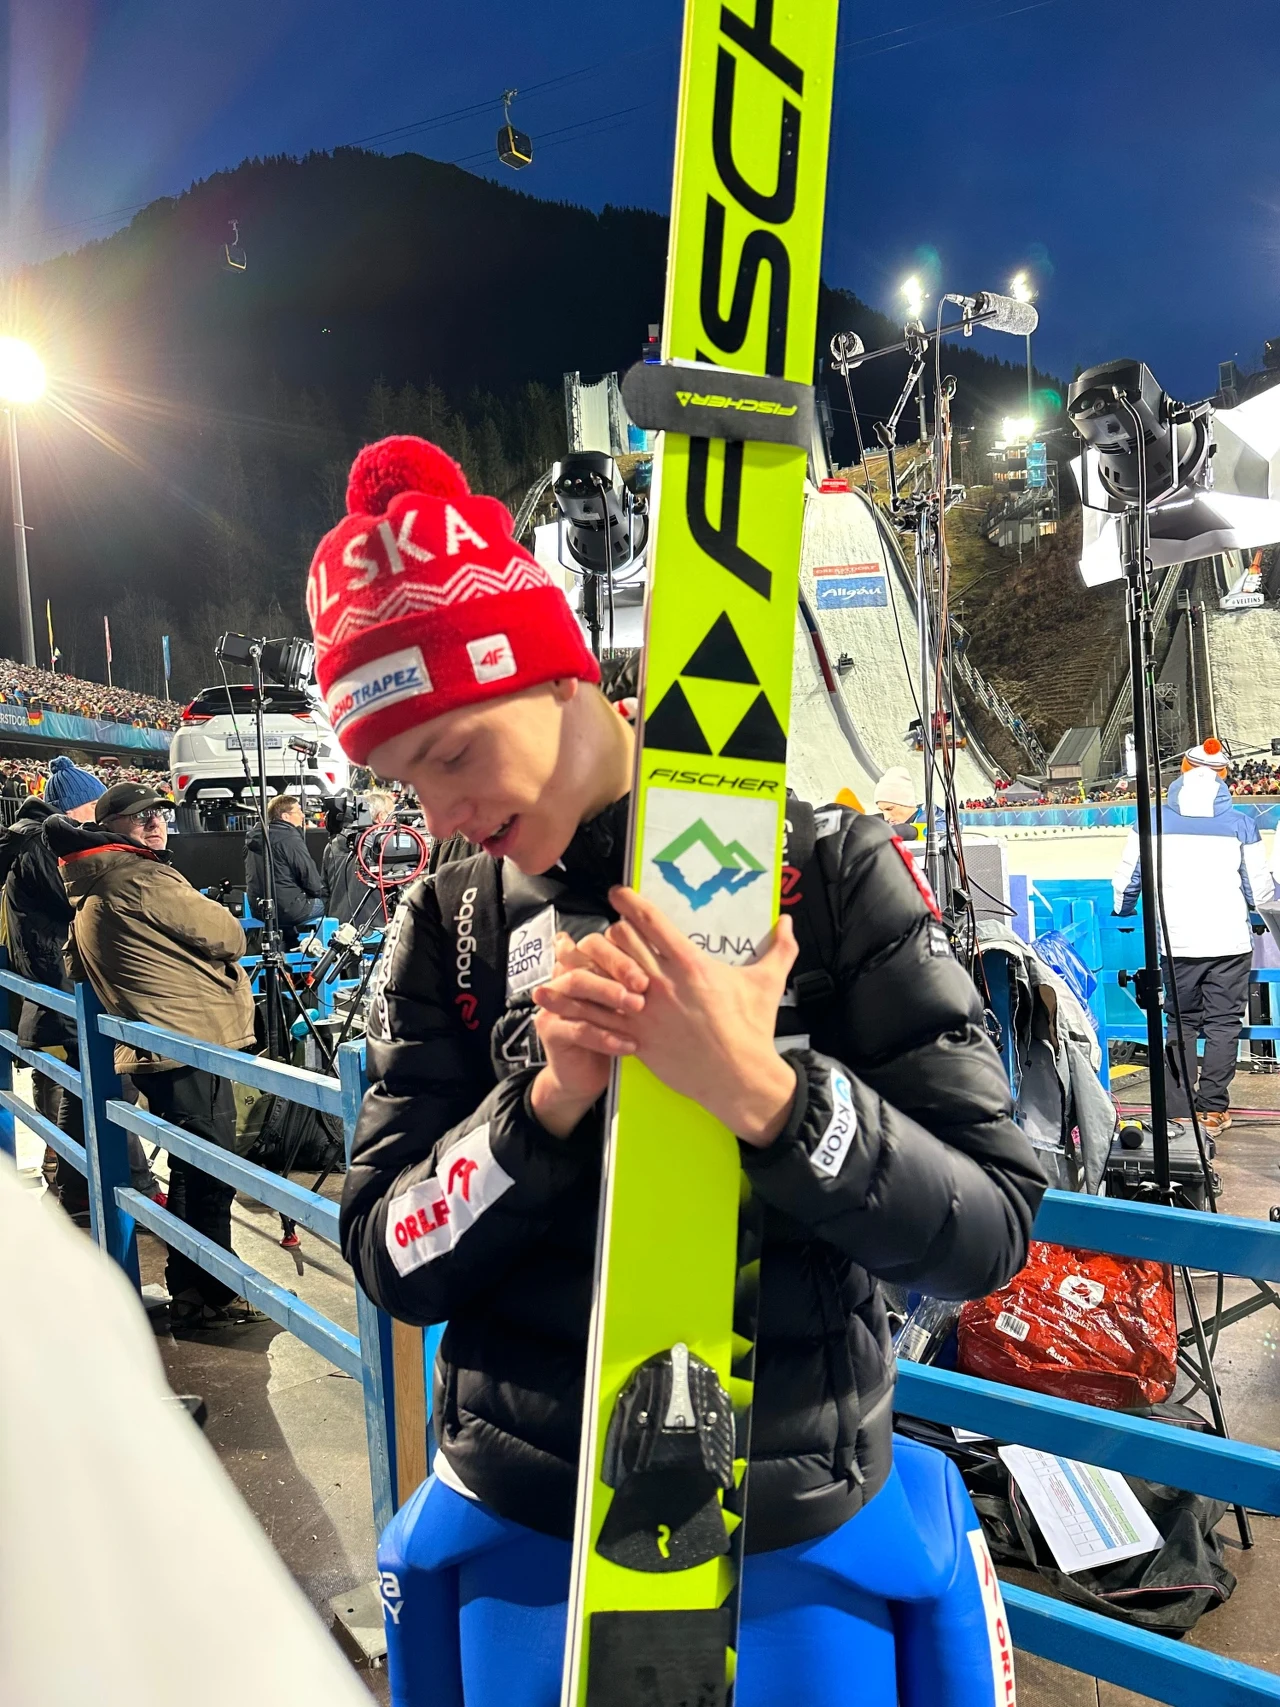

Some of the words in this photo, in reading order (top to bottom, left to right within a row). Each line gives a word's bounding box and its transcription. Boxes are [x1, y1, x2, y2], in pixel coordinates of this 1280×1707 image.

[690, 392, 798, 416] FISCHER
[1236, 597, 1261, 605] VELTINS
[480, 647, 505, 667] 4F
[648, 768, 780, 793] FISCHER
[453, 887, 478, 989] nagaba
[394, 1196, 451, 1248] ORLE
[996, 1618, 1015, 1707] ORL
